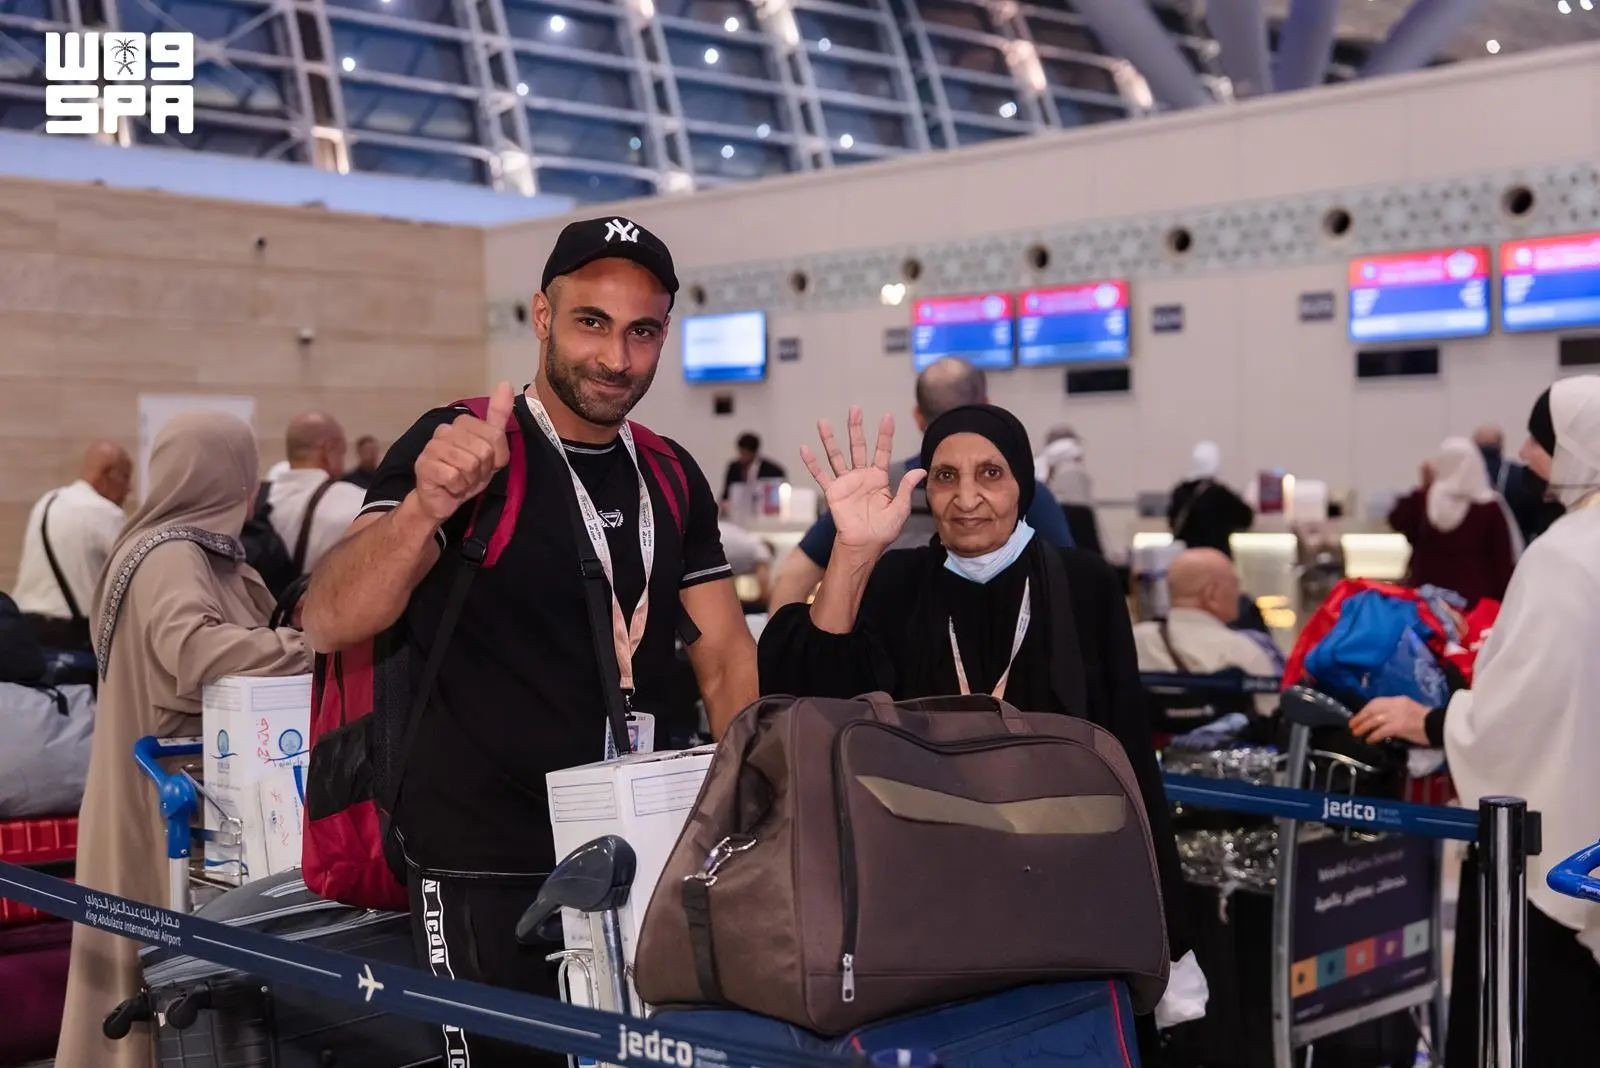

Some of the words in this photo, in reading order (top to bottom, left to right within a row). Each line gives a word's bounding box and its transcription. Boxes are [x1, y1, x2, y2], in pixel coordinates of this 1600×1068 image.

[604, 218, 640, 243] NY
[1322, 797, 1376, 821] jedco
[85, 909, 98, 926] King
[98, 914, 123, 931] Abdulaziz
[124, 921, 160, 940] International
[161, 930, 181, 947] Airport
[140, 908, 160, 925] الملك
[161, 911, 180, 929] مطار
[426, 910, 445, 964] ICON
[617, 1023, 693, 1068] jedco
